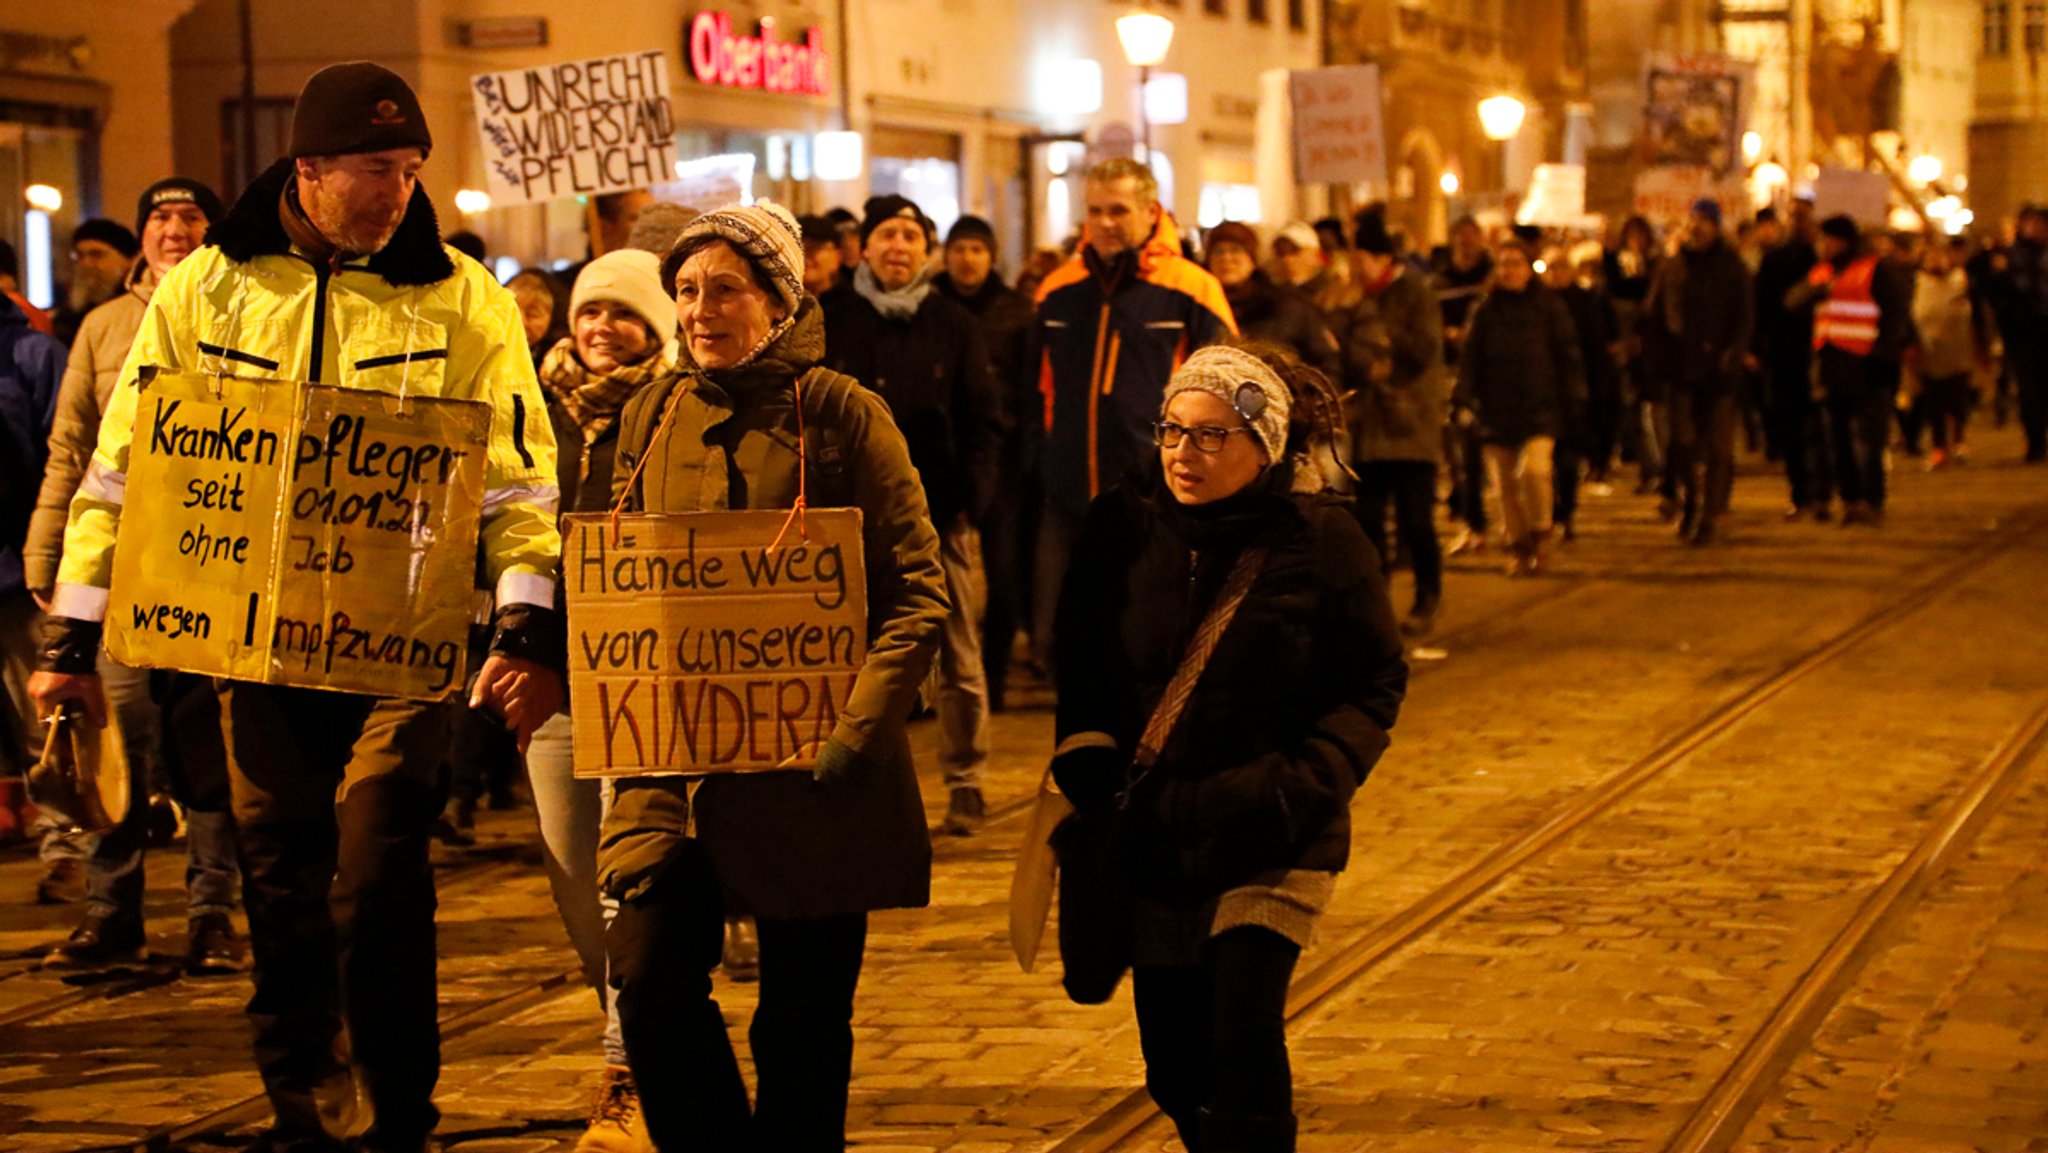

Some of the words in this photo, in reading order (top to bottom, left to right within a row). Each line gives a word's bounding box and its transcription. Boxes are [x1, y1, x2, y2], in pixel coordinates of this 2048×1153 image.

[498, 51, 665, 113] UNRECHT
[691, 10, 832, 96] Oberbank
[504, 96, 675, 156] WIDERSTAND
[521, 140, 675, 200] PFLICHT
[182, 473, 244, 513] seit
[179, 523, 249, 567] ohne
[292, 535, 354, 574] Job
[579, 525, 729, 593] Hände
[741, 542, 847, 611] weg
[133, 603, 211, 639] wegen
[581, 626, 660, 672] von
[677, 622, 855, 674] unseren
